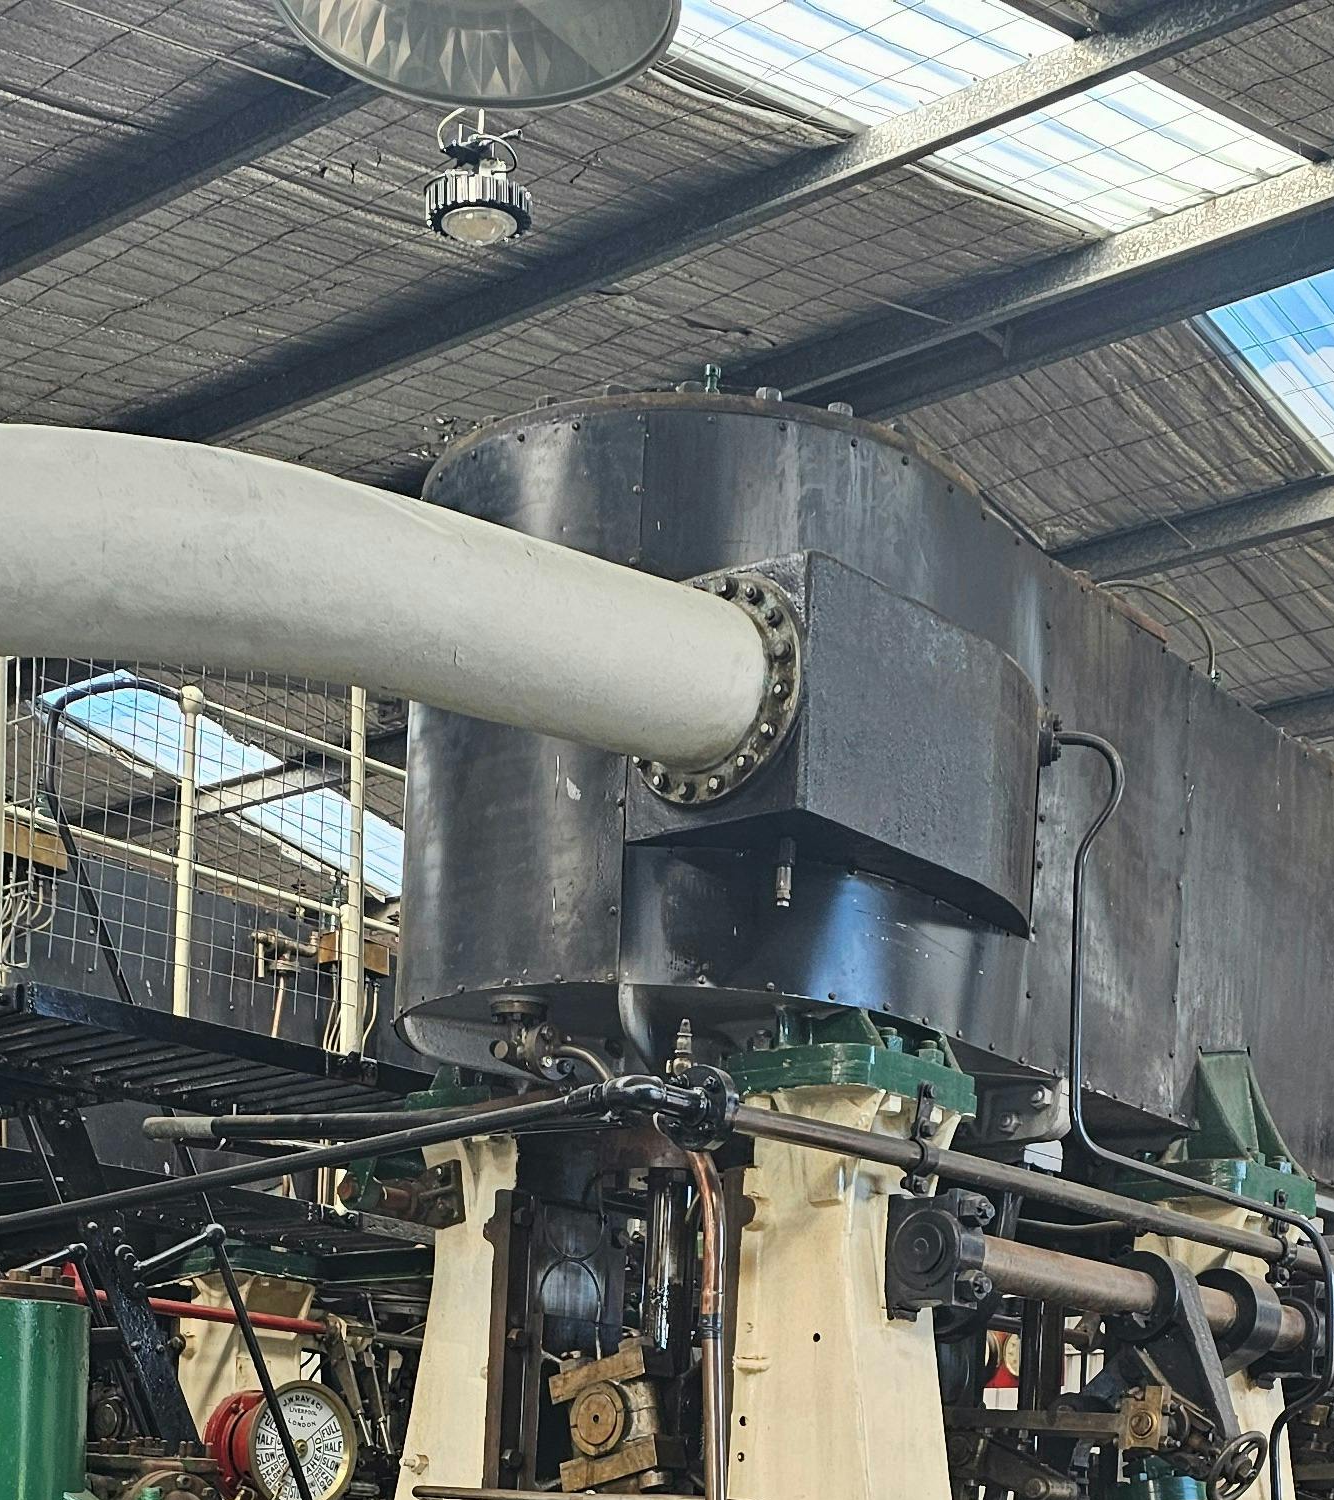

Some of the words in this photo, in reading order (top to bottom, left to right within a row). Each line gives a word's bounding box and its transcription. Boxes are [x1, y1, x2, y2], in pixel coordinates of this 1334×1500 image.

[289, 1407, 318, 1416] LIVERPOOL
[288, 1419, 317, 1427] LONDON
[321, 1420, 340, 1438] FULL
[324, 1441, 342, 1453] HALF
[256, 1452, 276, 1466] SLOW
[306, 1437, 322, 1474] AHEAD
[321, 1457, 339, 1472] SLOW
